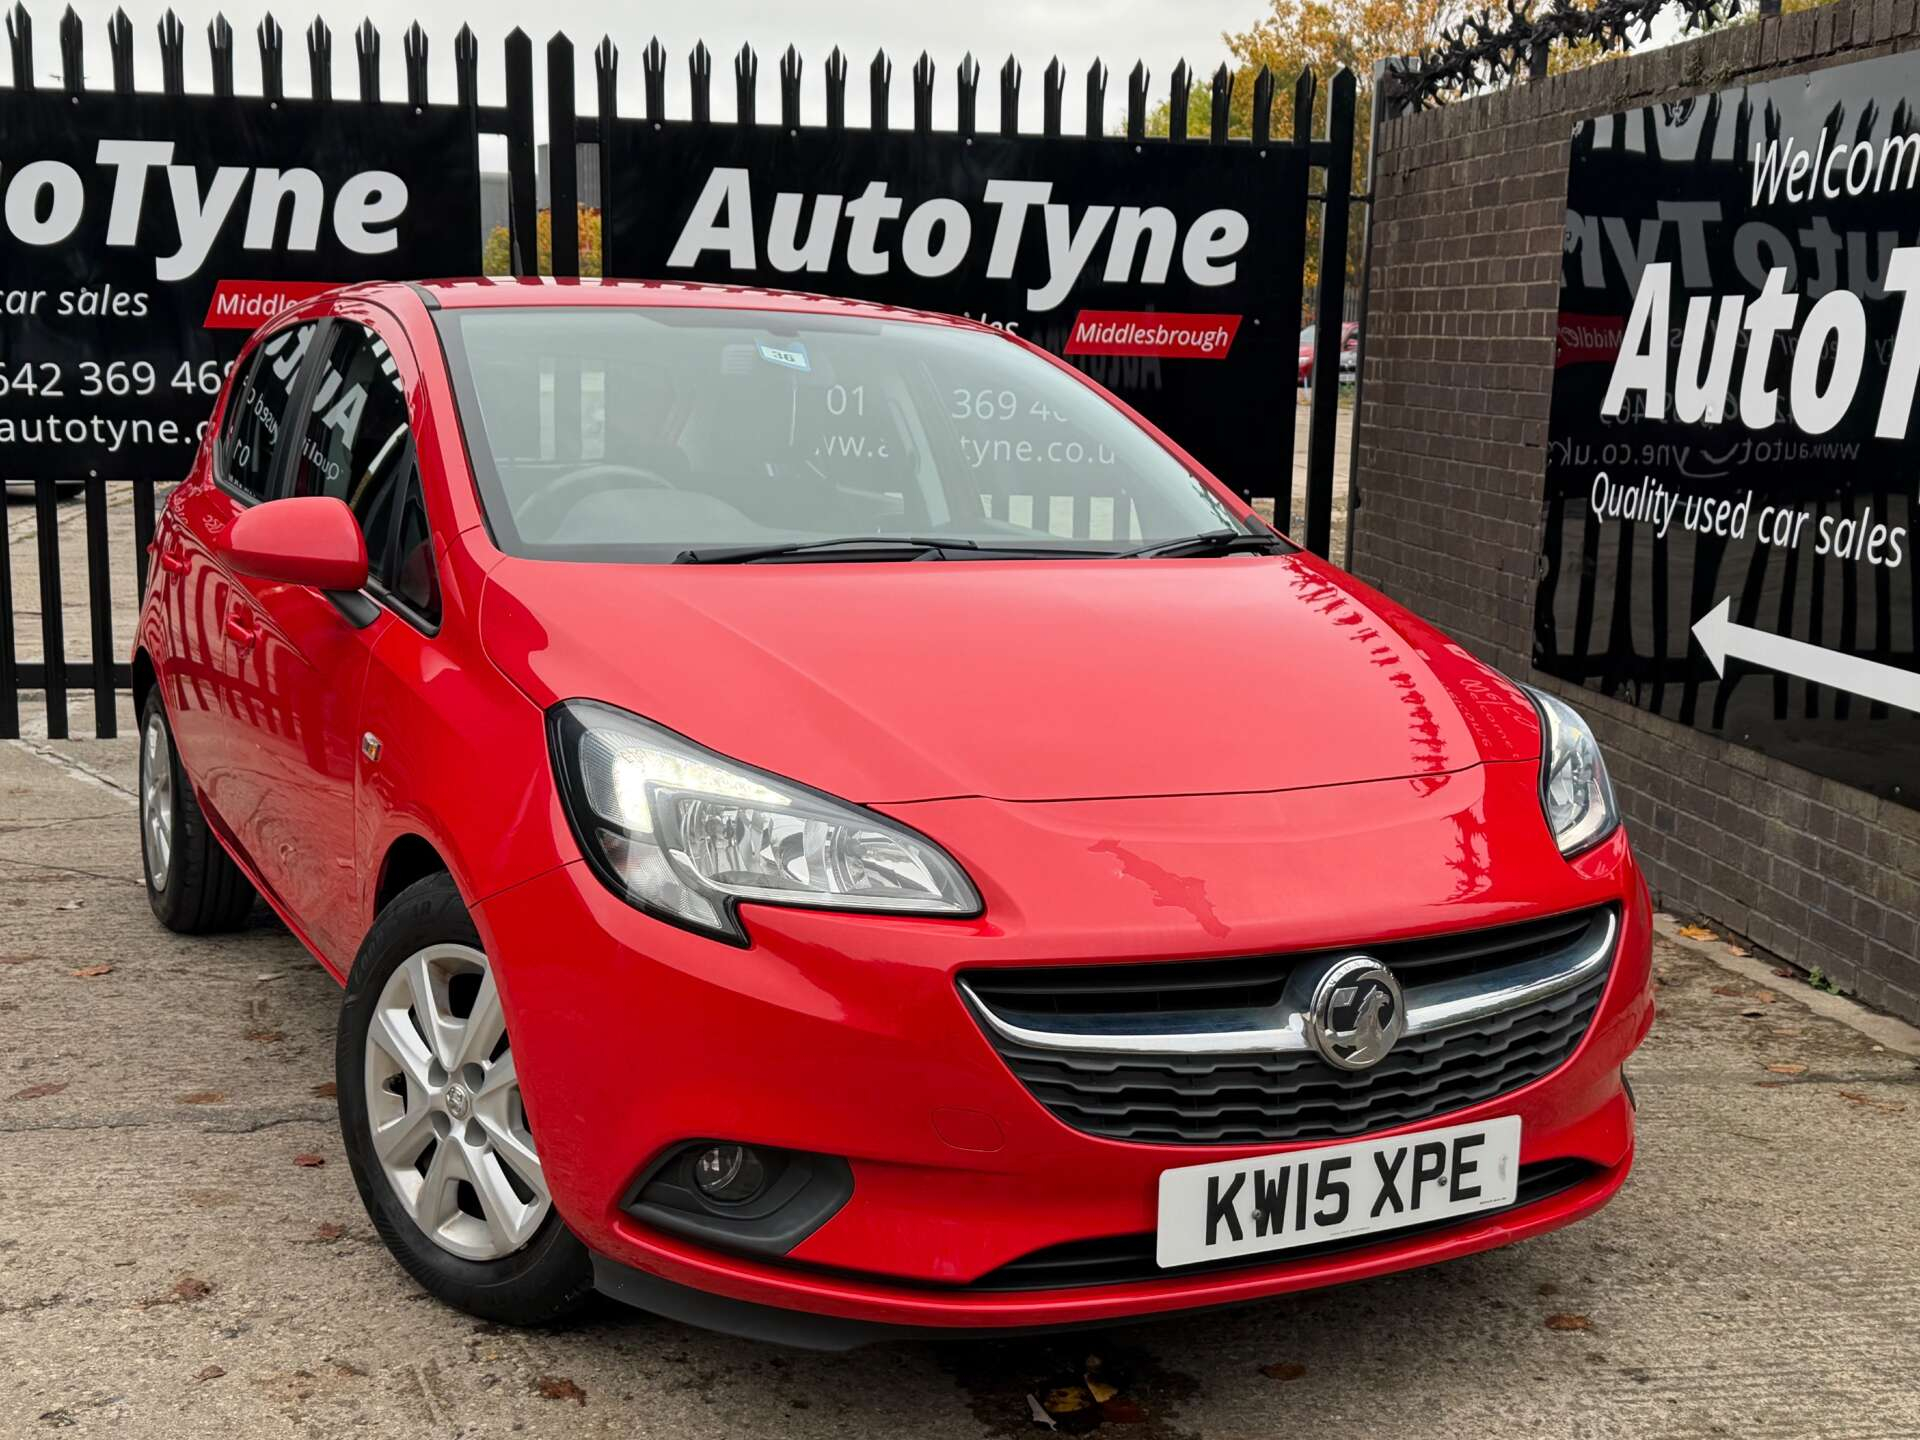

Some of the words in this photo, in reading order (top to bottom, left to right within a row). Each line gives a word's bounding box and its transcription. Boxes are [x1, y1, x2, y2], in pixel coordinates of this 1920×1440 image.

[0, 139, 409, 282] oTyne
[666, 166, 1250, 311] AutoTyne
[0, 290, 47, 315] ar
[57, 283, 149, 317] sales
[1075, 322, 1229, 353] Middlesbrough
[78, 360, 156, 396] 369
[170, 360, 234, 396] 46
[951, 389, 1017, 420] 369
[1591, 471, 1679, 539] Quality
[1684, 490, 1753, 540] used
[1757, 506, 1810, 549] car
[1815, 506, 1907, 568] sales
[1204, 1155, 1352, 1247] KW15
[1369, 1132, 1486, 1219] XPE
